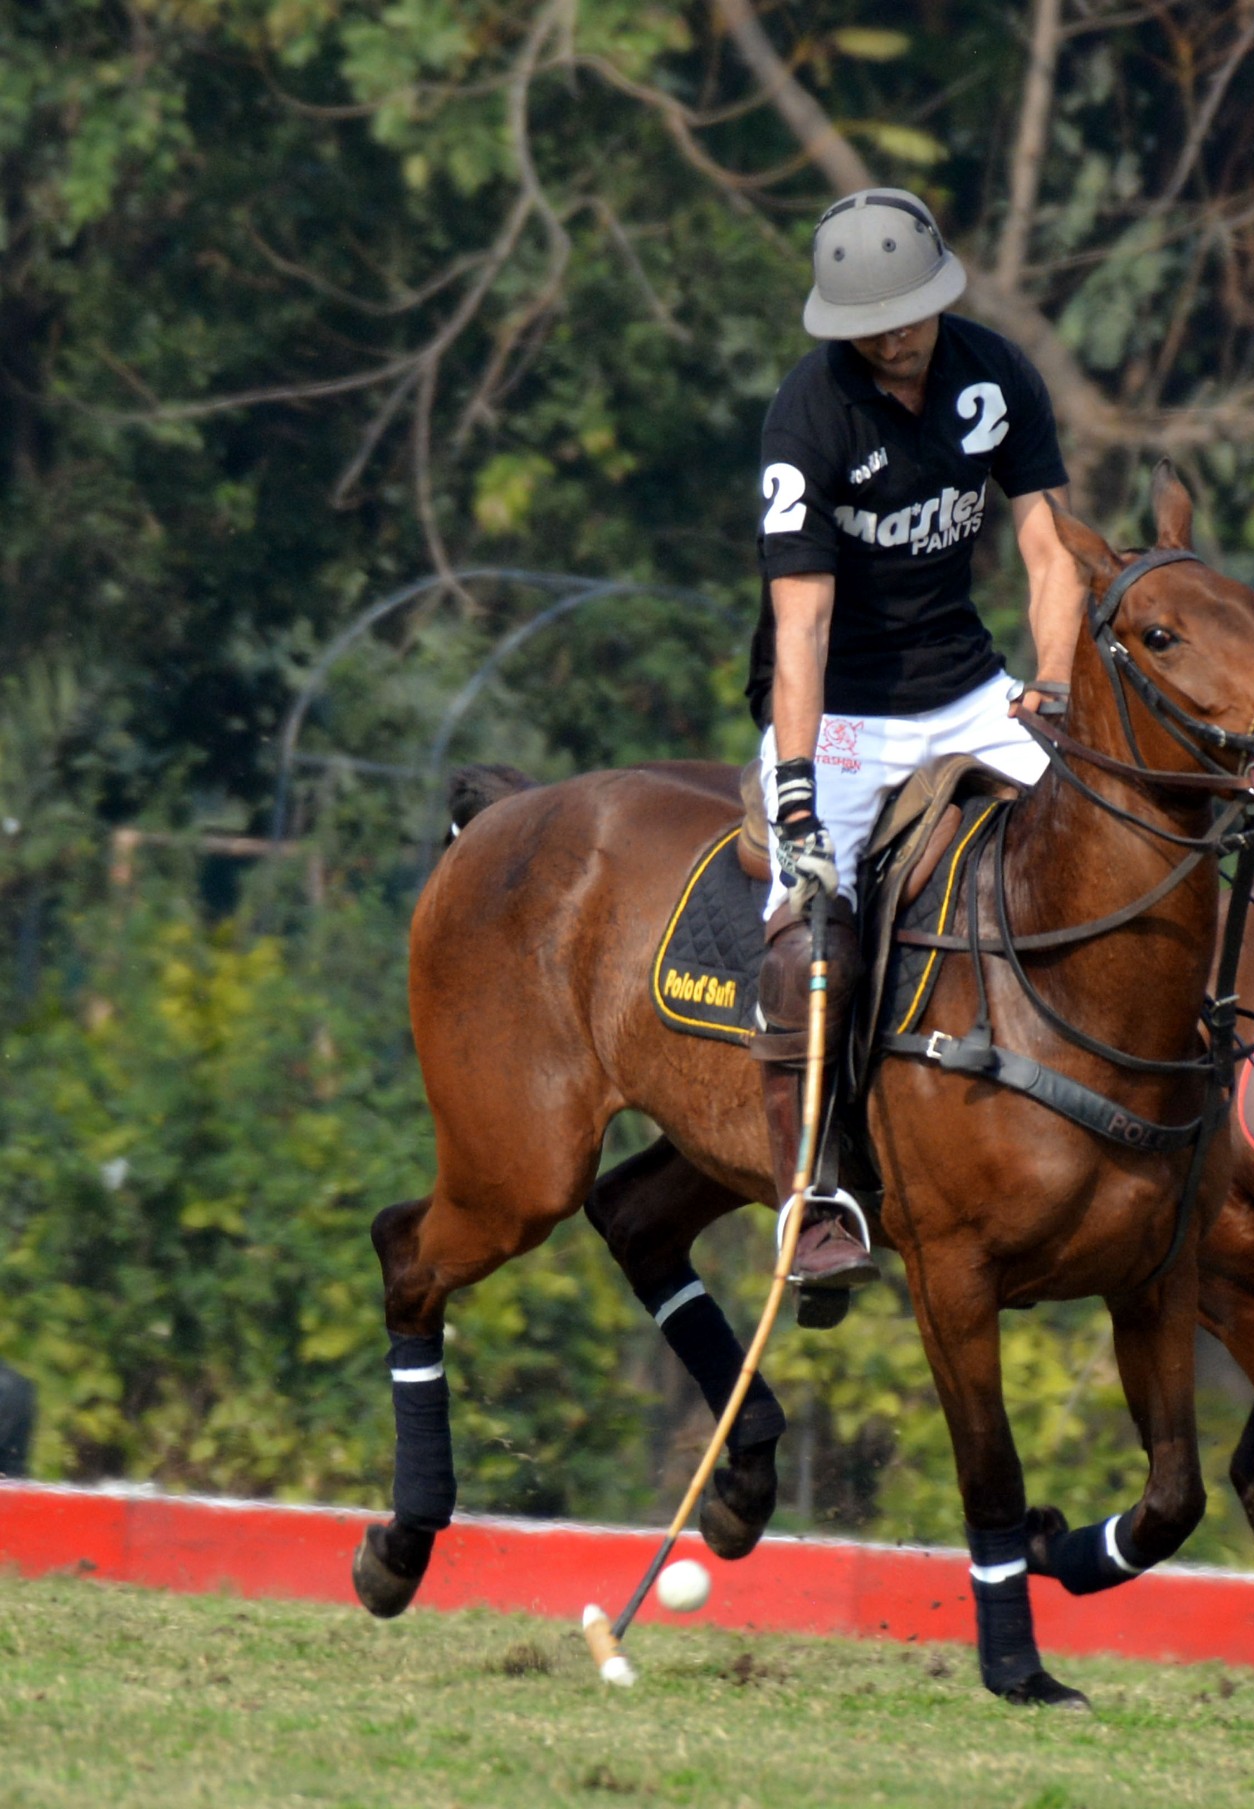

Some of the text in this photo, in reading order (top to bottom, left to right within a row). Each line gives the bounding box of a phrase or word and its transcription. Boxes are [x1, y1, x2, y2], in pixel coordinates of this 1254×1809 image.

[957, 382, 1010, 455] 2
[762, 462, 807, 535] 2
[911, 512, 983, 556] PAINTS
